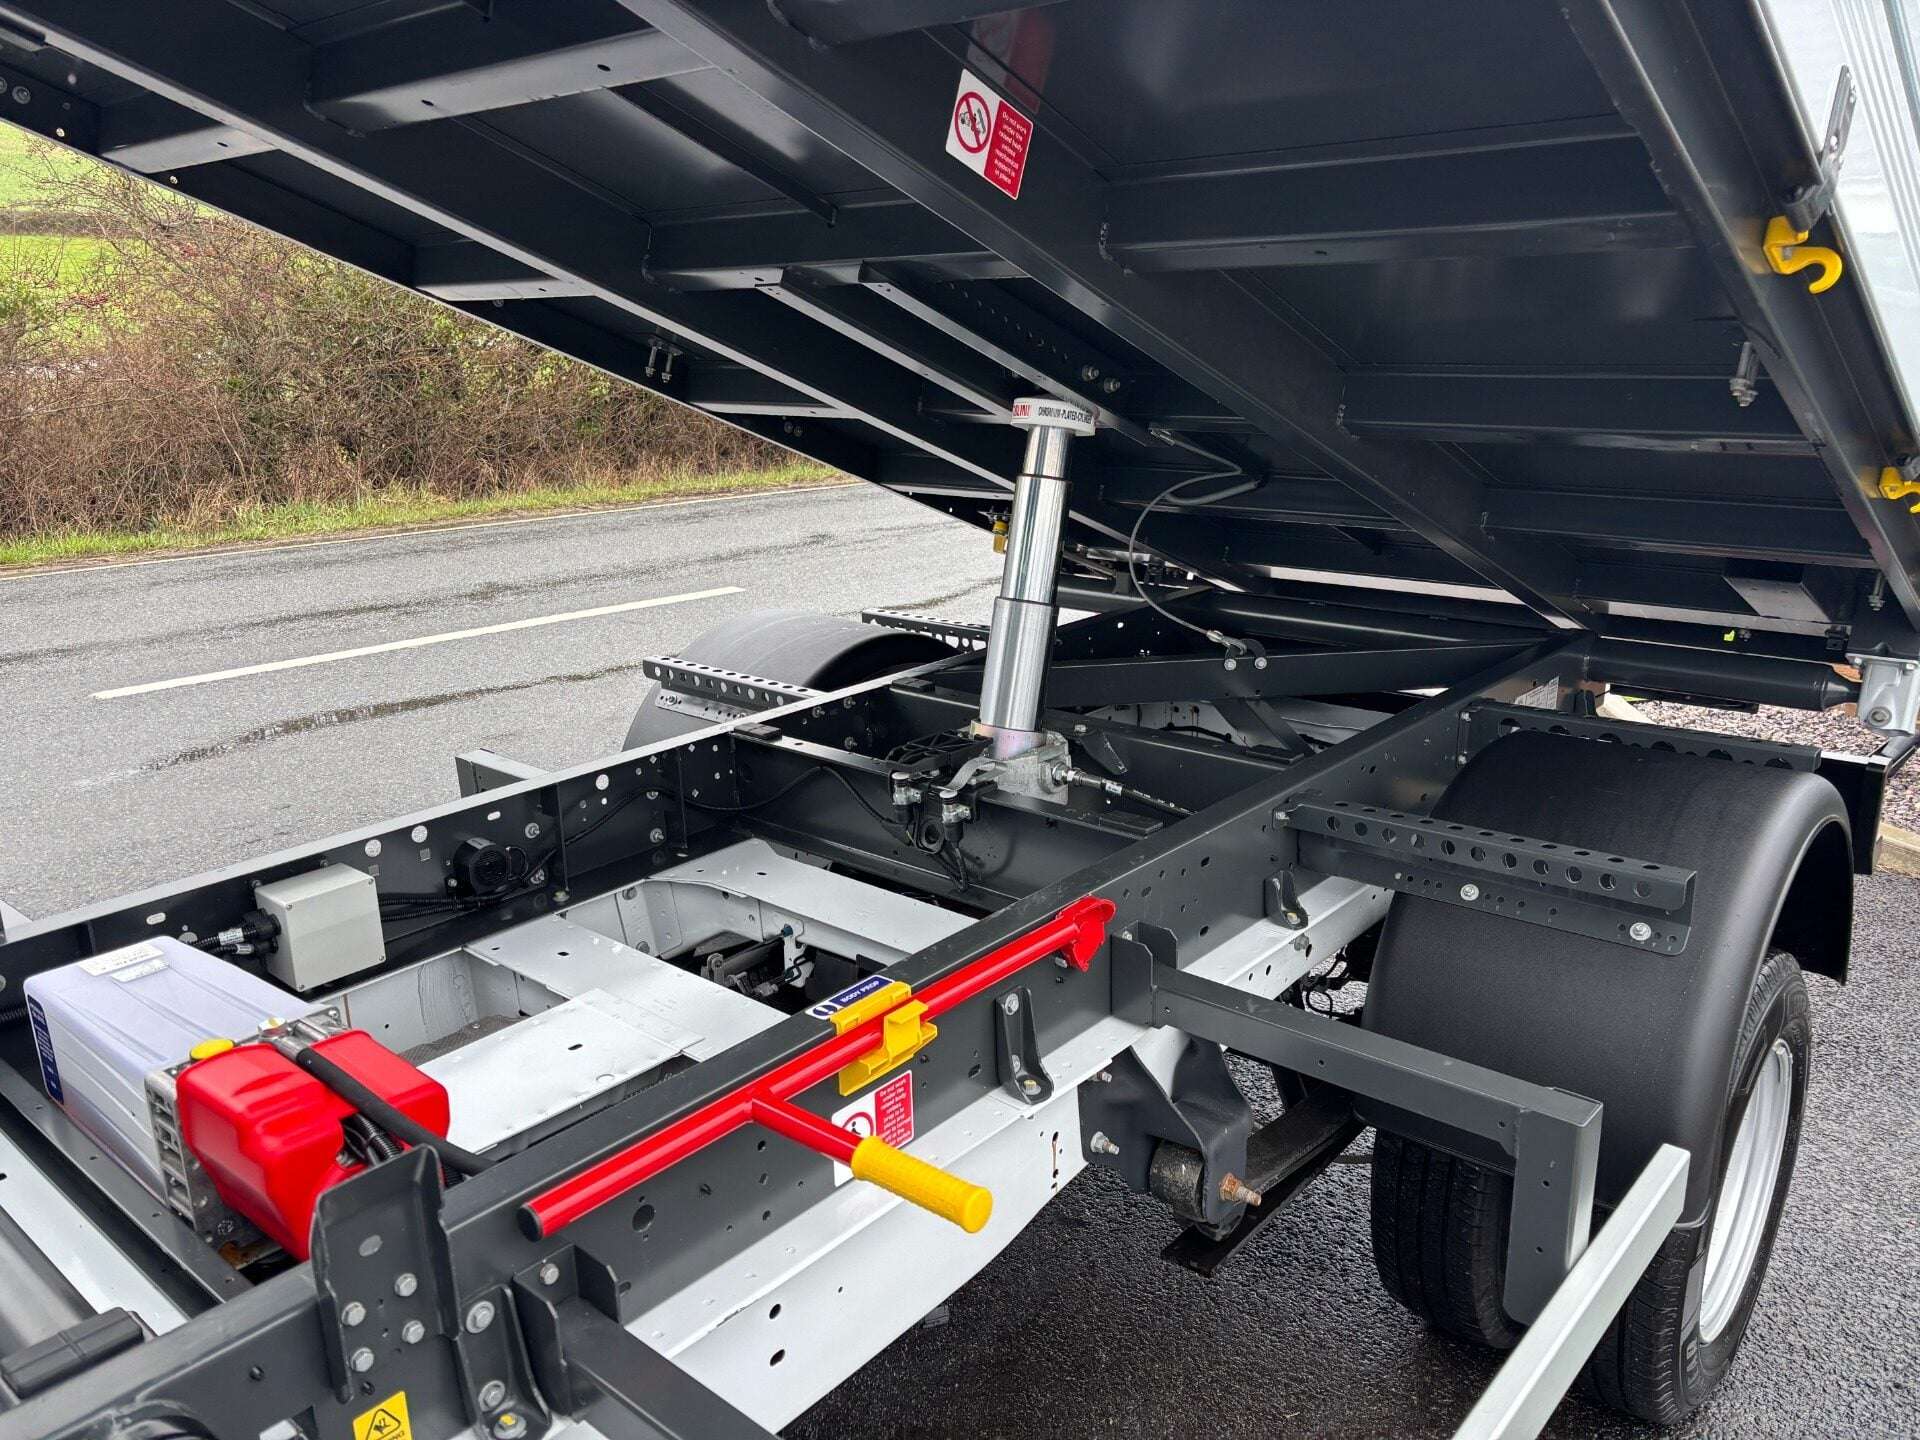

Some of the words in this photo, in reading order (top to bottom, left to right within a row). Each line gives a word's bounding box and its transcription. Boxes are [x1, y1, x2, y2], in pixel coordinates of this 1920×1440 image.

[1002, 123, 1015, 136] under
[1016, 123, 1026, 134] work
[998, 130, 1012, 143] raised
[1011, 139, 1022, 152] body
[1001, 143, 1015, 157] unless
[840, 991, 861, 1003] BODY
[860, 980, 880, 992] PROP
